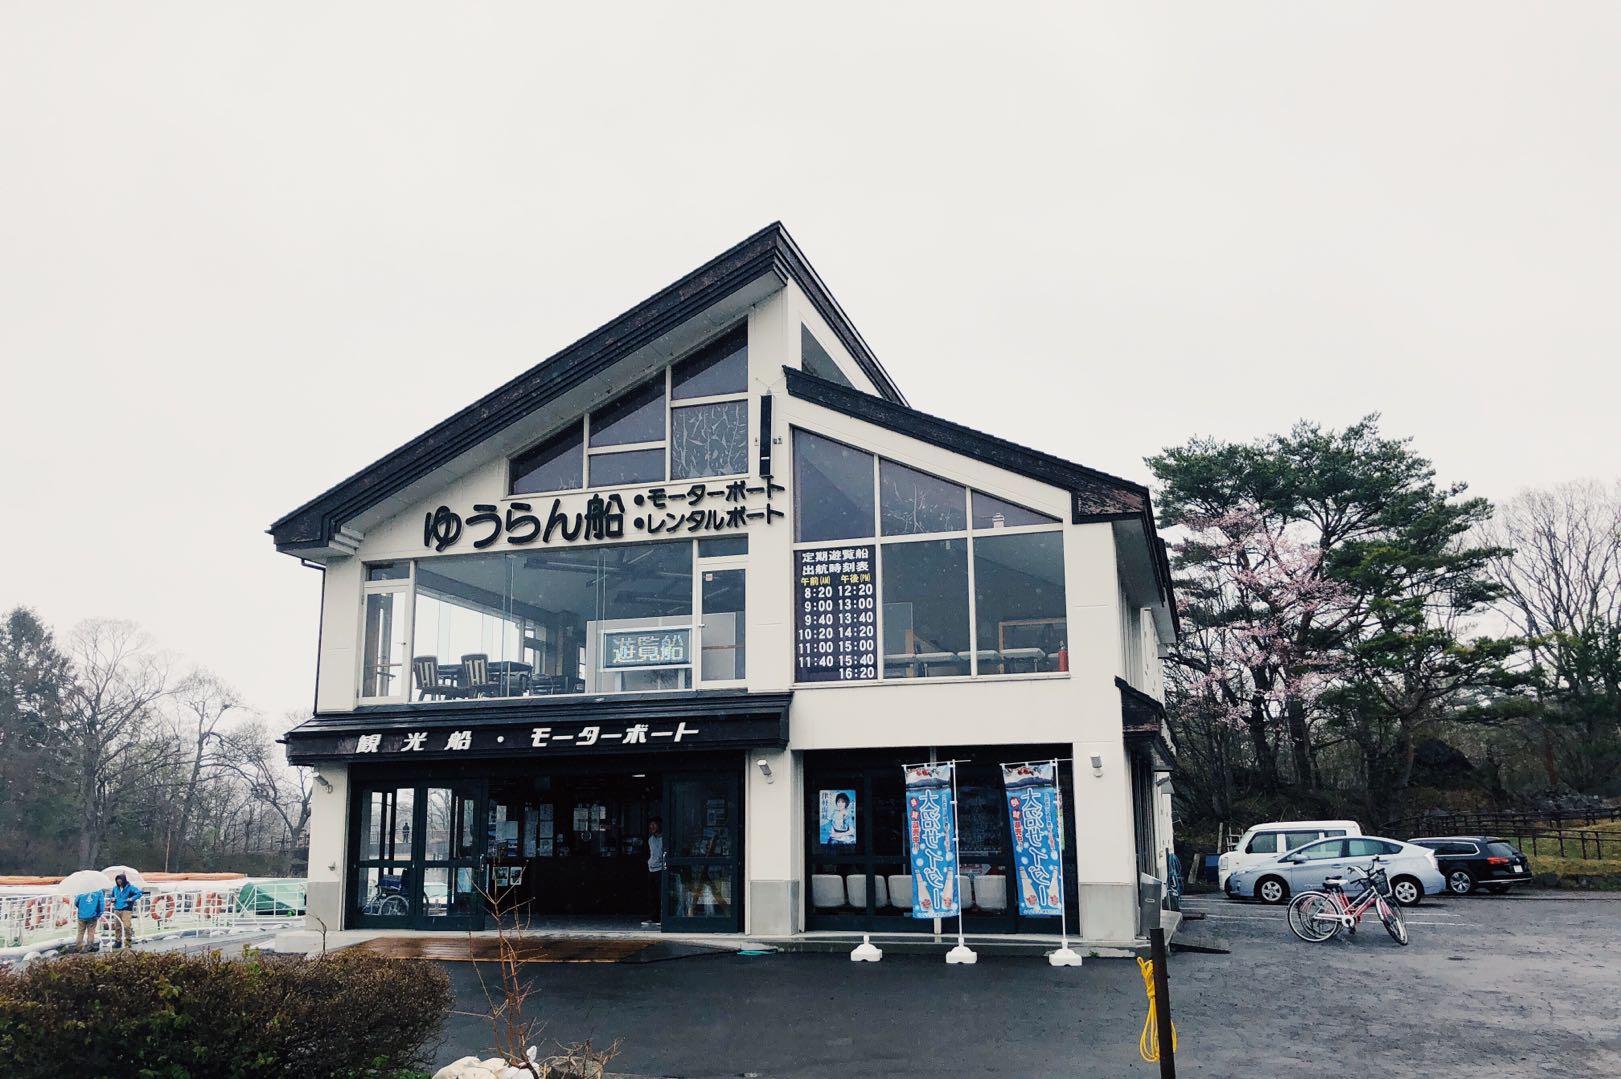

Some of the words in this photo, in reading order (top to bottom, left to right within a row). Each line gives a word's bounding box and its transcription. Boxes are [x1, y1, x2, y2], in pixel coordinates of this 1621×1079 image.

[424, 493, 626, 552] ゆうらん船
[802, 548, 869, 563] 定期遊覧船
[802, 561, 869, 576] 出航時刻表
[804, 586, 832, 598] 8:20
[838, 584, 873, 597] 12:20
[804, 600, 833, 612] 9:00
[838, 598, 873, 610] 13:00
[804, 614, 833, 626] 9:40
[838, 612, 874, 624] 13:40
[799, 628, 833, 640] 10:20
[838, 626, 874, 638] 14:20
[799, 642, 834, 654] 11:00
[838, 640, 874, 652] 15:00
[799, 656, 834, 668] 11:40
[839, 654, 874, 666] 15:40
[839, 667, 875, 679] 16:20
